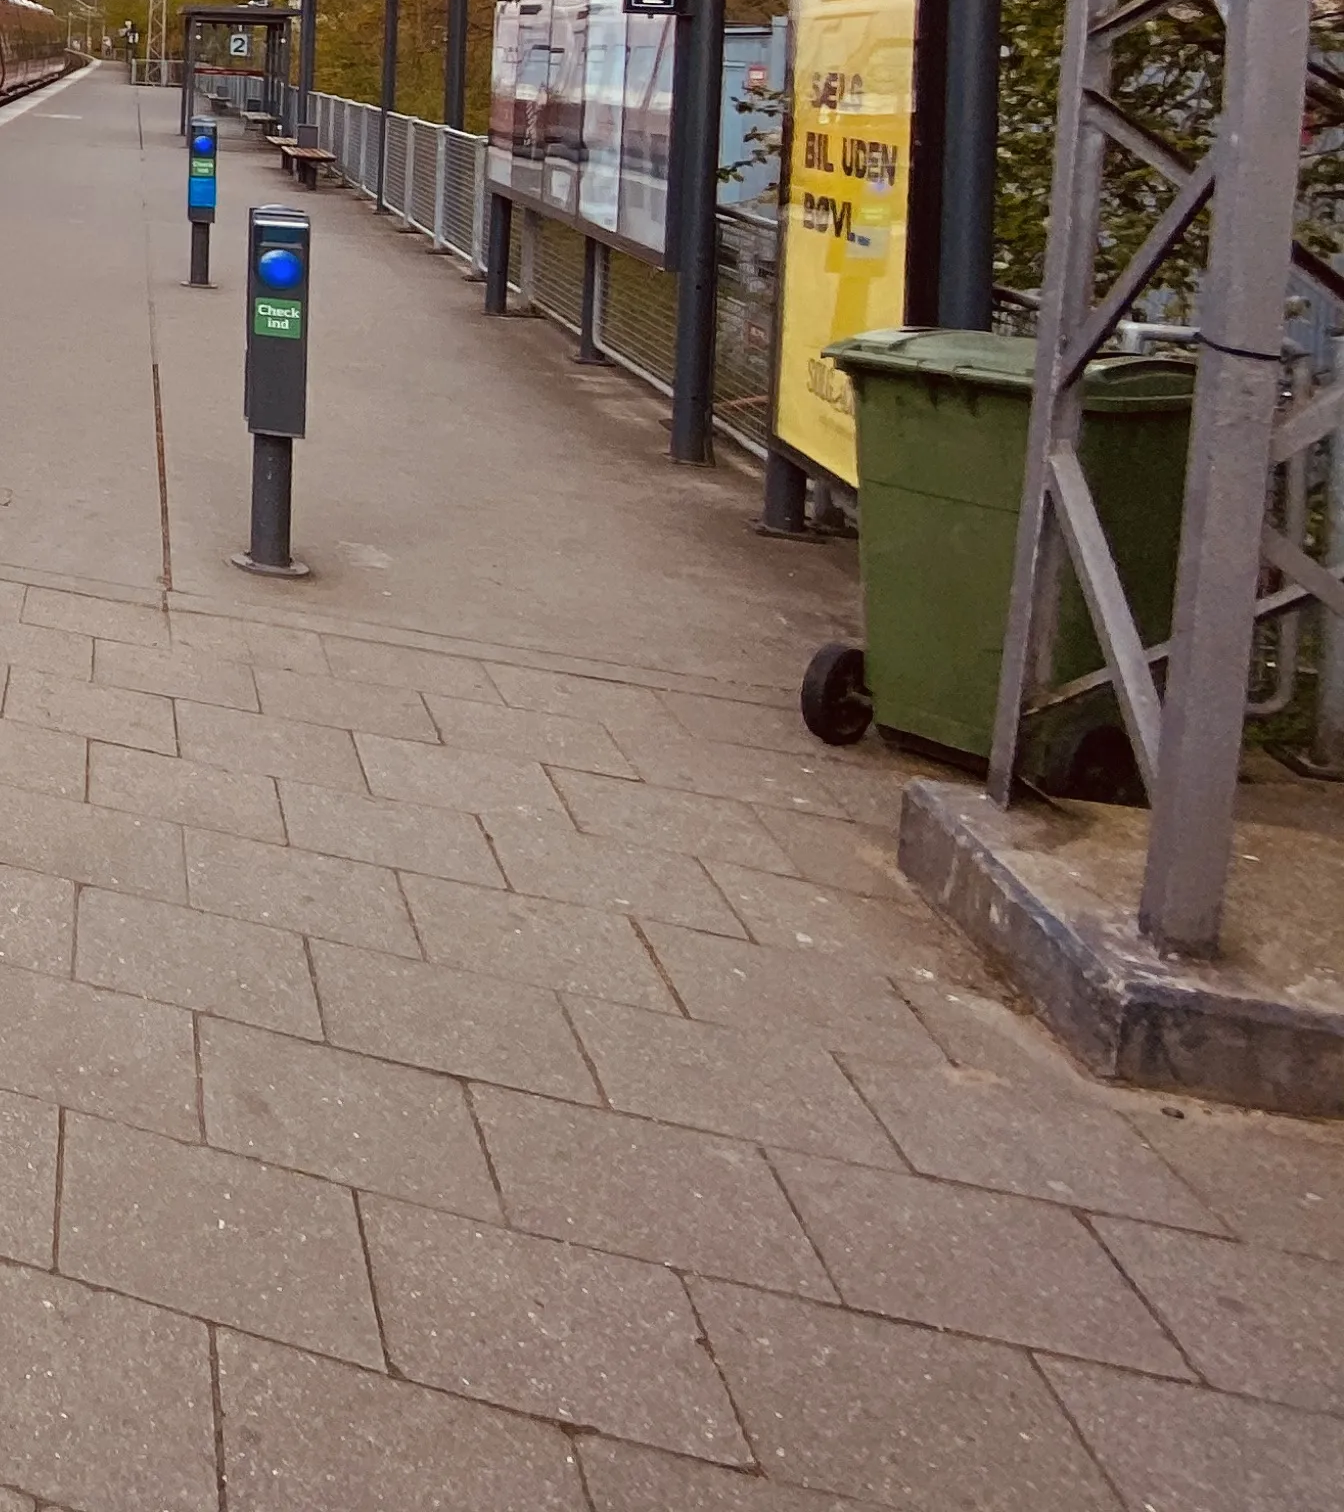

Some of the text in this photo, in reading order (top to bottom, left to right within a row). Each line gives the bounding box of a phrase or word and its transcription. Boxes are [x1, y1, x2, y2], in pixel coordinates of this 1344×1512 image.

[233, 37, 246, 53] 2
[804, 131, 898, 187] BIL UDEN
[257, 304, 301, 319] Check
[267, 317, 290, 330] ind
